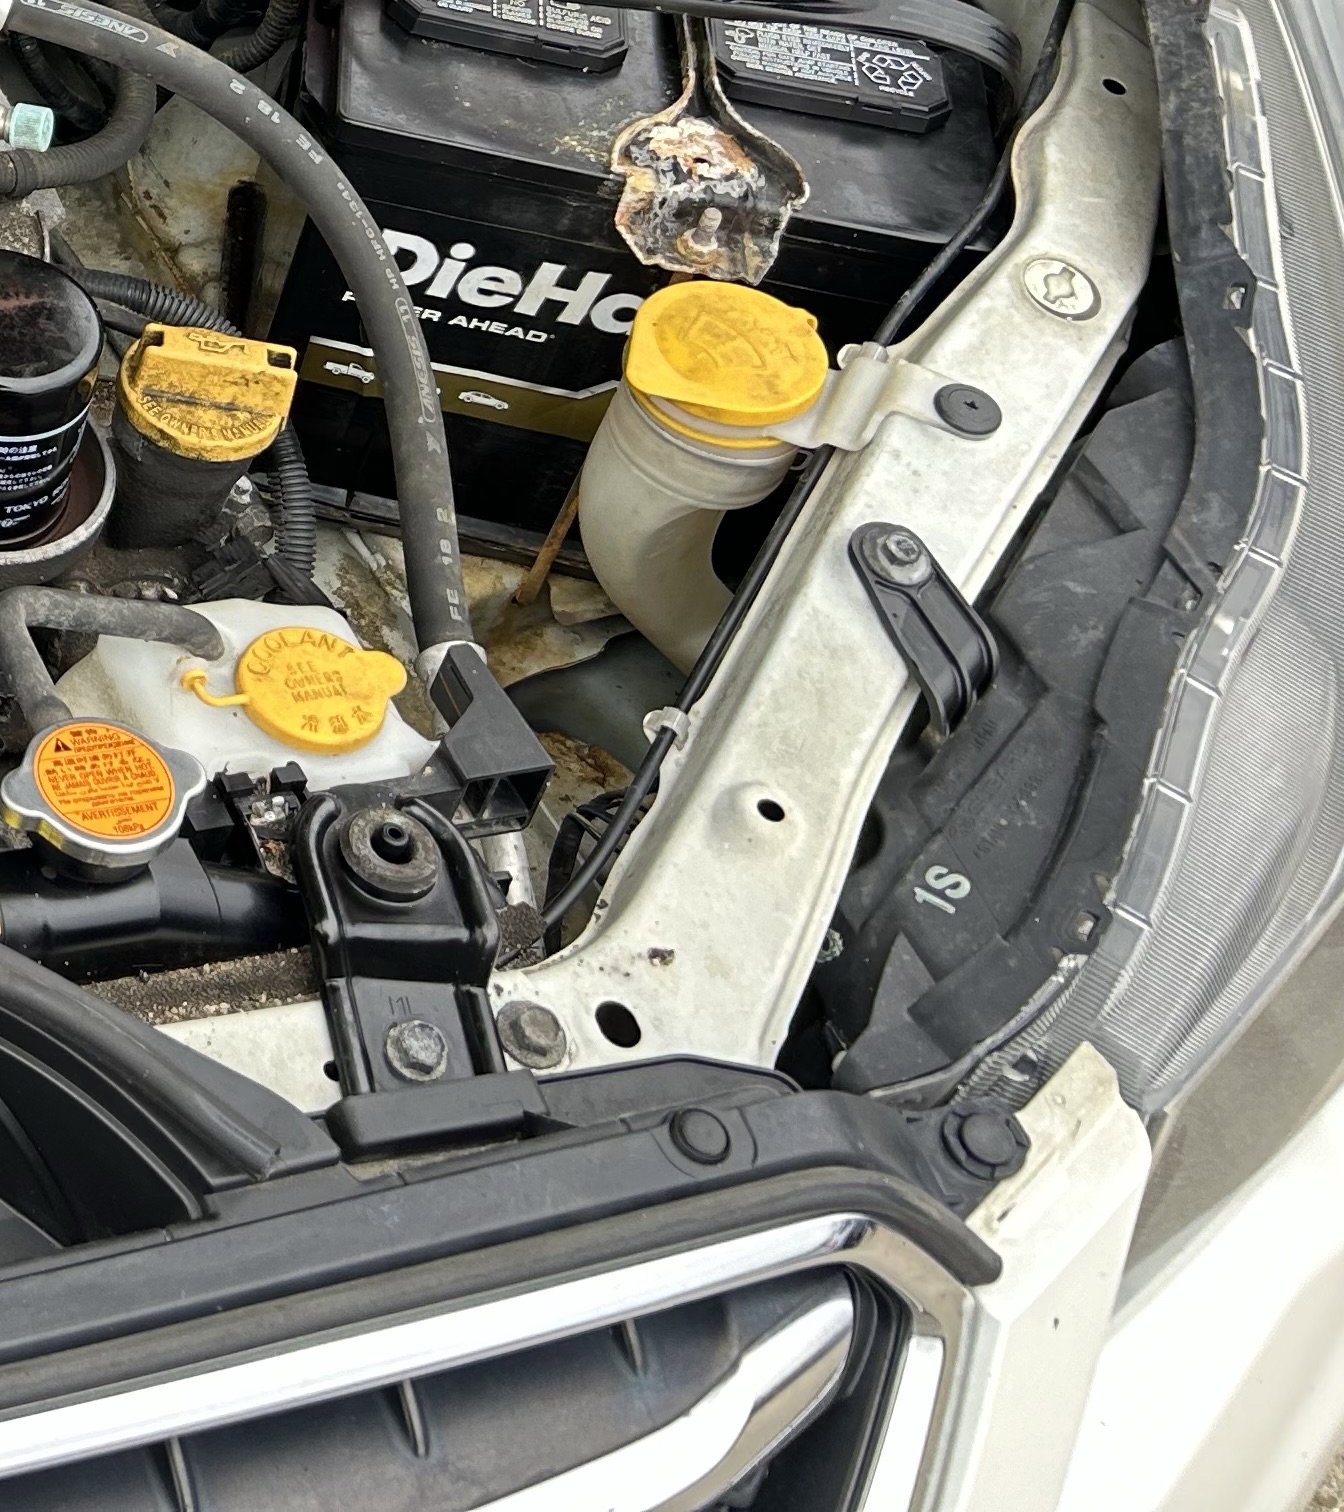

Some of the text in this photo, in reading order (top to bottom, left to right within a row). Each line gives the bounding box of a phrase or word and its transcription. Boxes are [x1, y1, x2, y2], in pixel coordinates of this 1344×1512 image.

[448, 314, 549, 343] AHEAD
[138, 395, 160, 416] SEE
[3, 495, 49, 514] TOKYO
[247, 630, 356, 676] COOLANT
[285, 660, 317, 676] SEE
[290, 683, 348, 704] MANUAL
[71, 733, 121, 746] WARNING
[79, 769, 103, 780] OPEN
[105, 765, 132, 776] WHEN
[136, 761, 152, 771] HOT
[81, 801, 159, 822] AVERTISSEMENT
[912, 864, 972, 915] 1S
